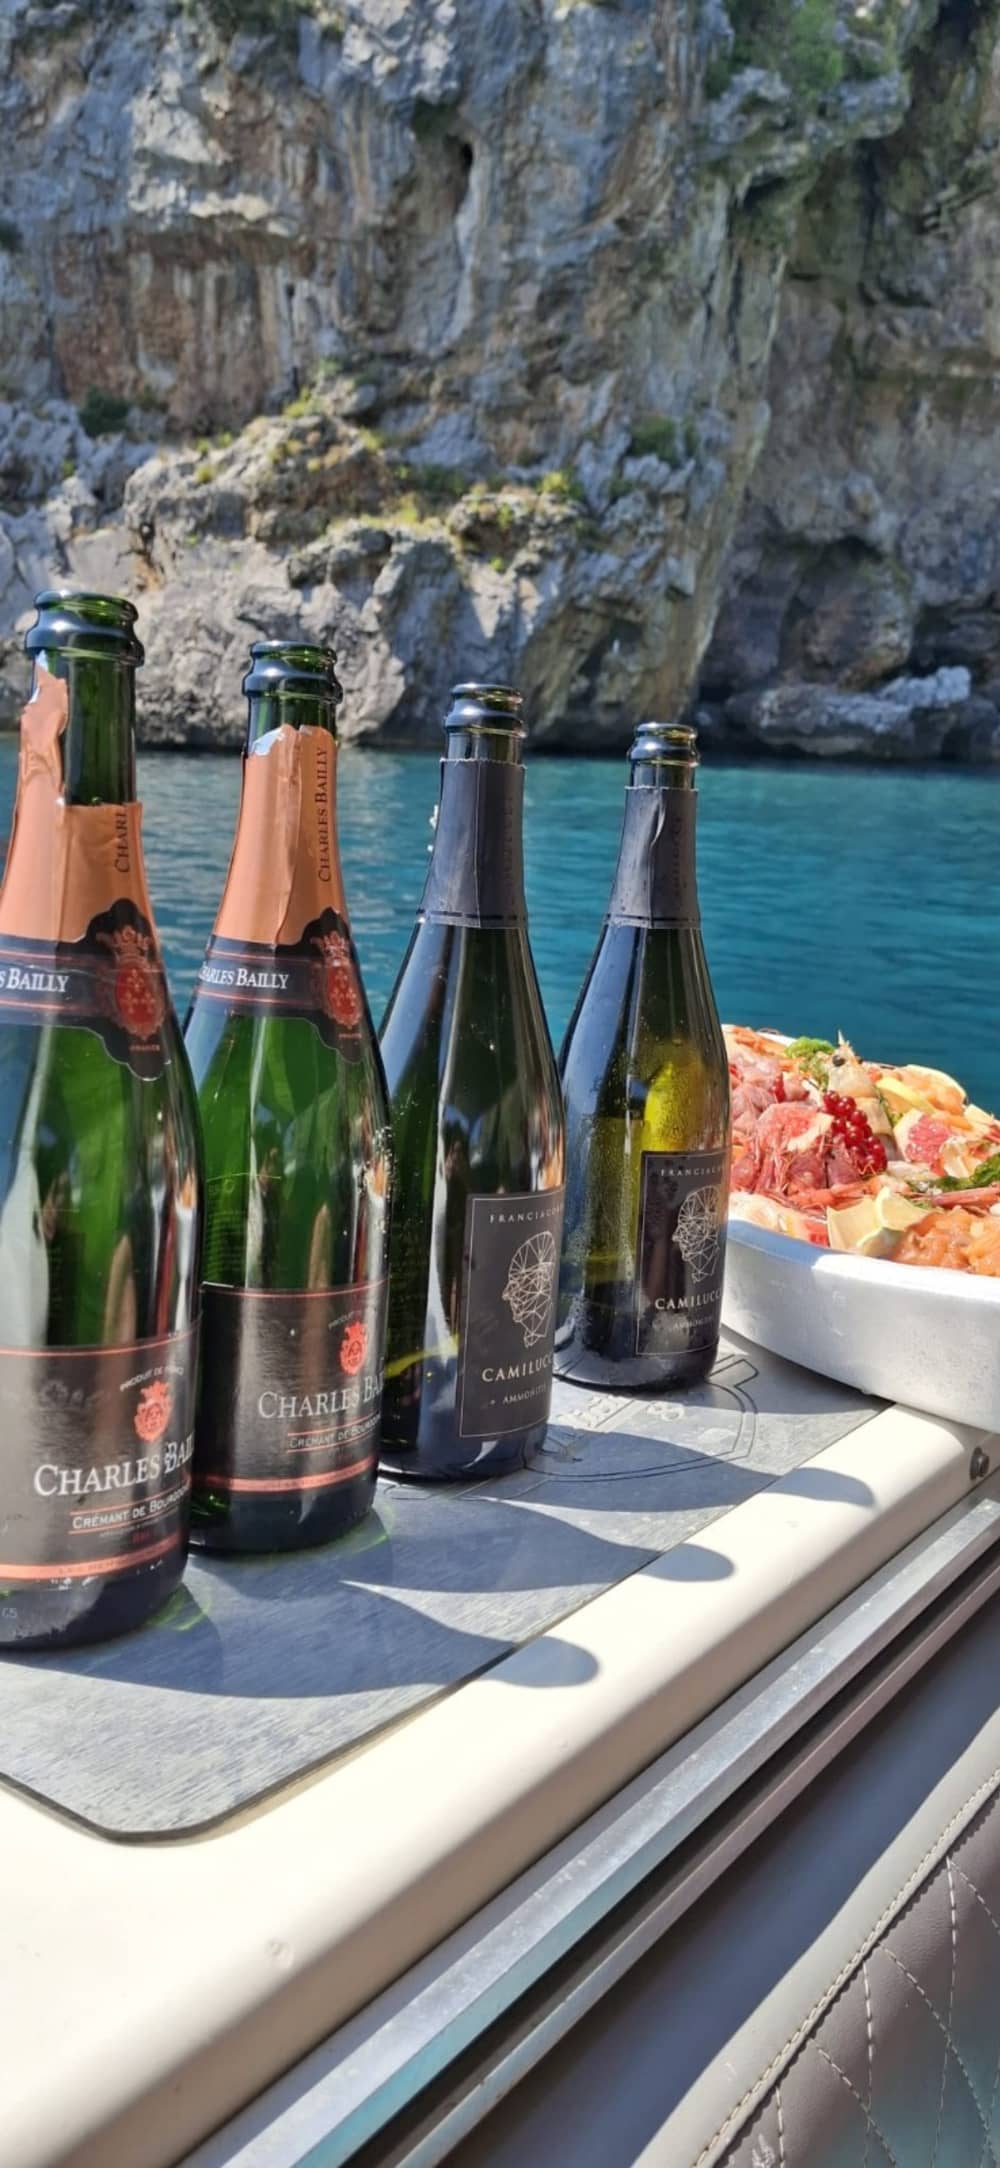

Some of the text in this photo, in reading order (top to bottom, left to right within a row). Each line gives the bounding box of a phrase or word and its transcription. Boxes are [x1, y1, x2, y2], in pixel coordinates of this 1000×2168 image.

[315, 749, 332, 883] CHARLES BAILLY
[114, 811, 131, 873] CHARL
[6, 967, 69, 993] BAILLY
[236, 967, 289, 989] BAILLY
[654, 1287, 722, 1311] CAMILUCC
[258, 1388, 361, 1419] CHARLES
[33, 1454, 161, 1497] CHARLES
[72, 1511, 130, 1530] CRÉMANT
[132, 1507, 147, 1520] DE
